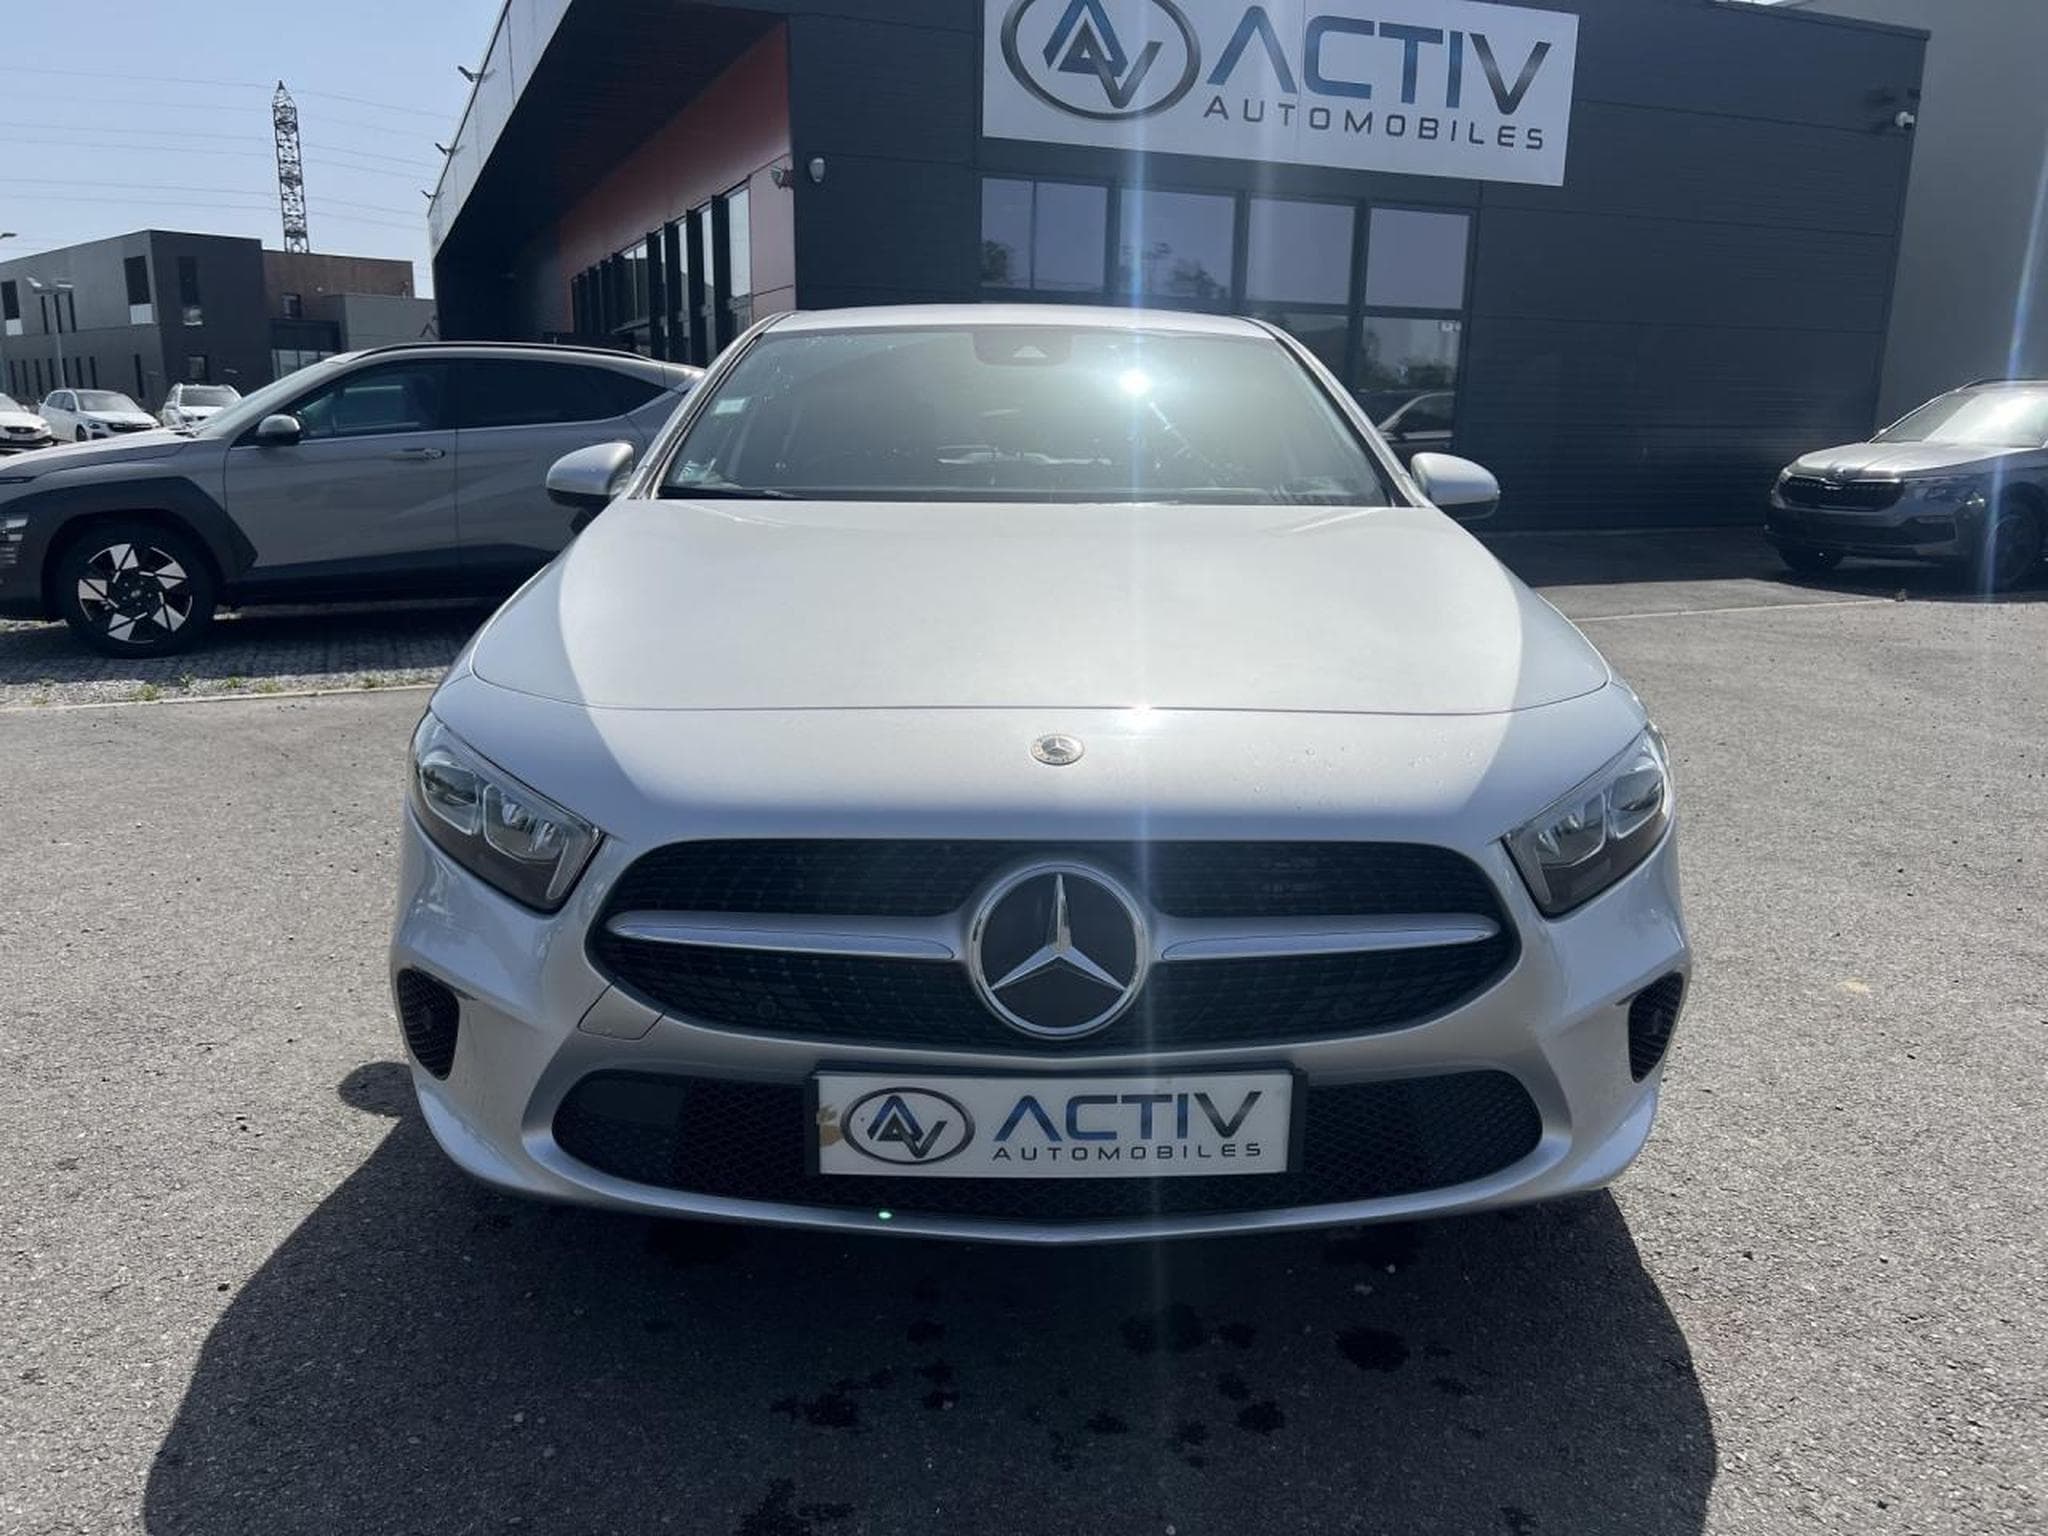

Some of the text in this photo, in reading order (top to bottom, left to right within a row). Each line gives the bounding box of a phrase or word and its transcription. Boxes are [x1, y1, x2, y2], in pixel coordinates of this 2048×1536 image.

[1206, 5, 1552, 115] ACTIV
[1204, 97, 1544, 151] AUTOMOBILES
[992, 1091, 1262, 1141] ACTIV
[992, 1142, 1262, 1163] AUTOMOBILES
